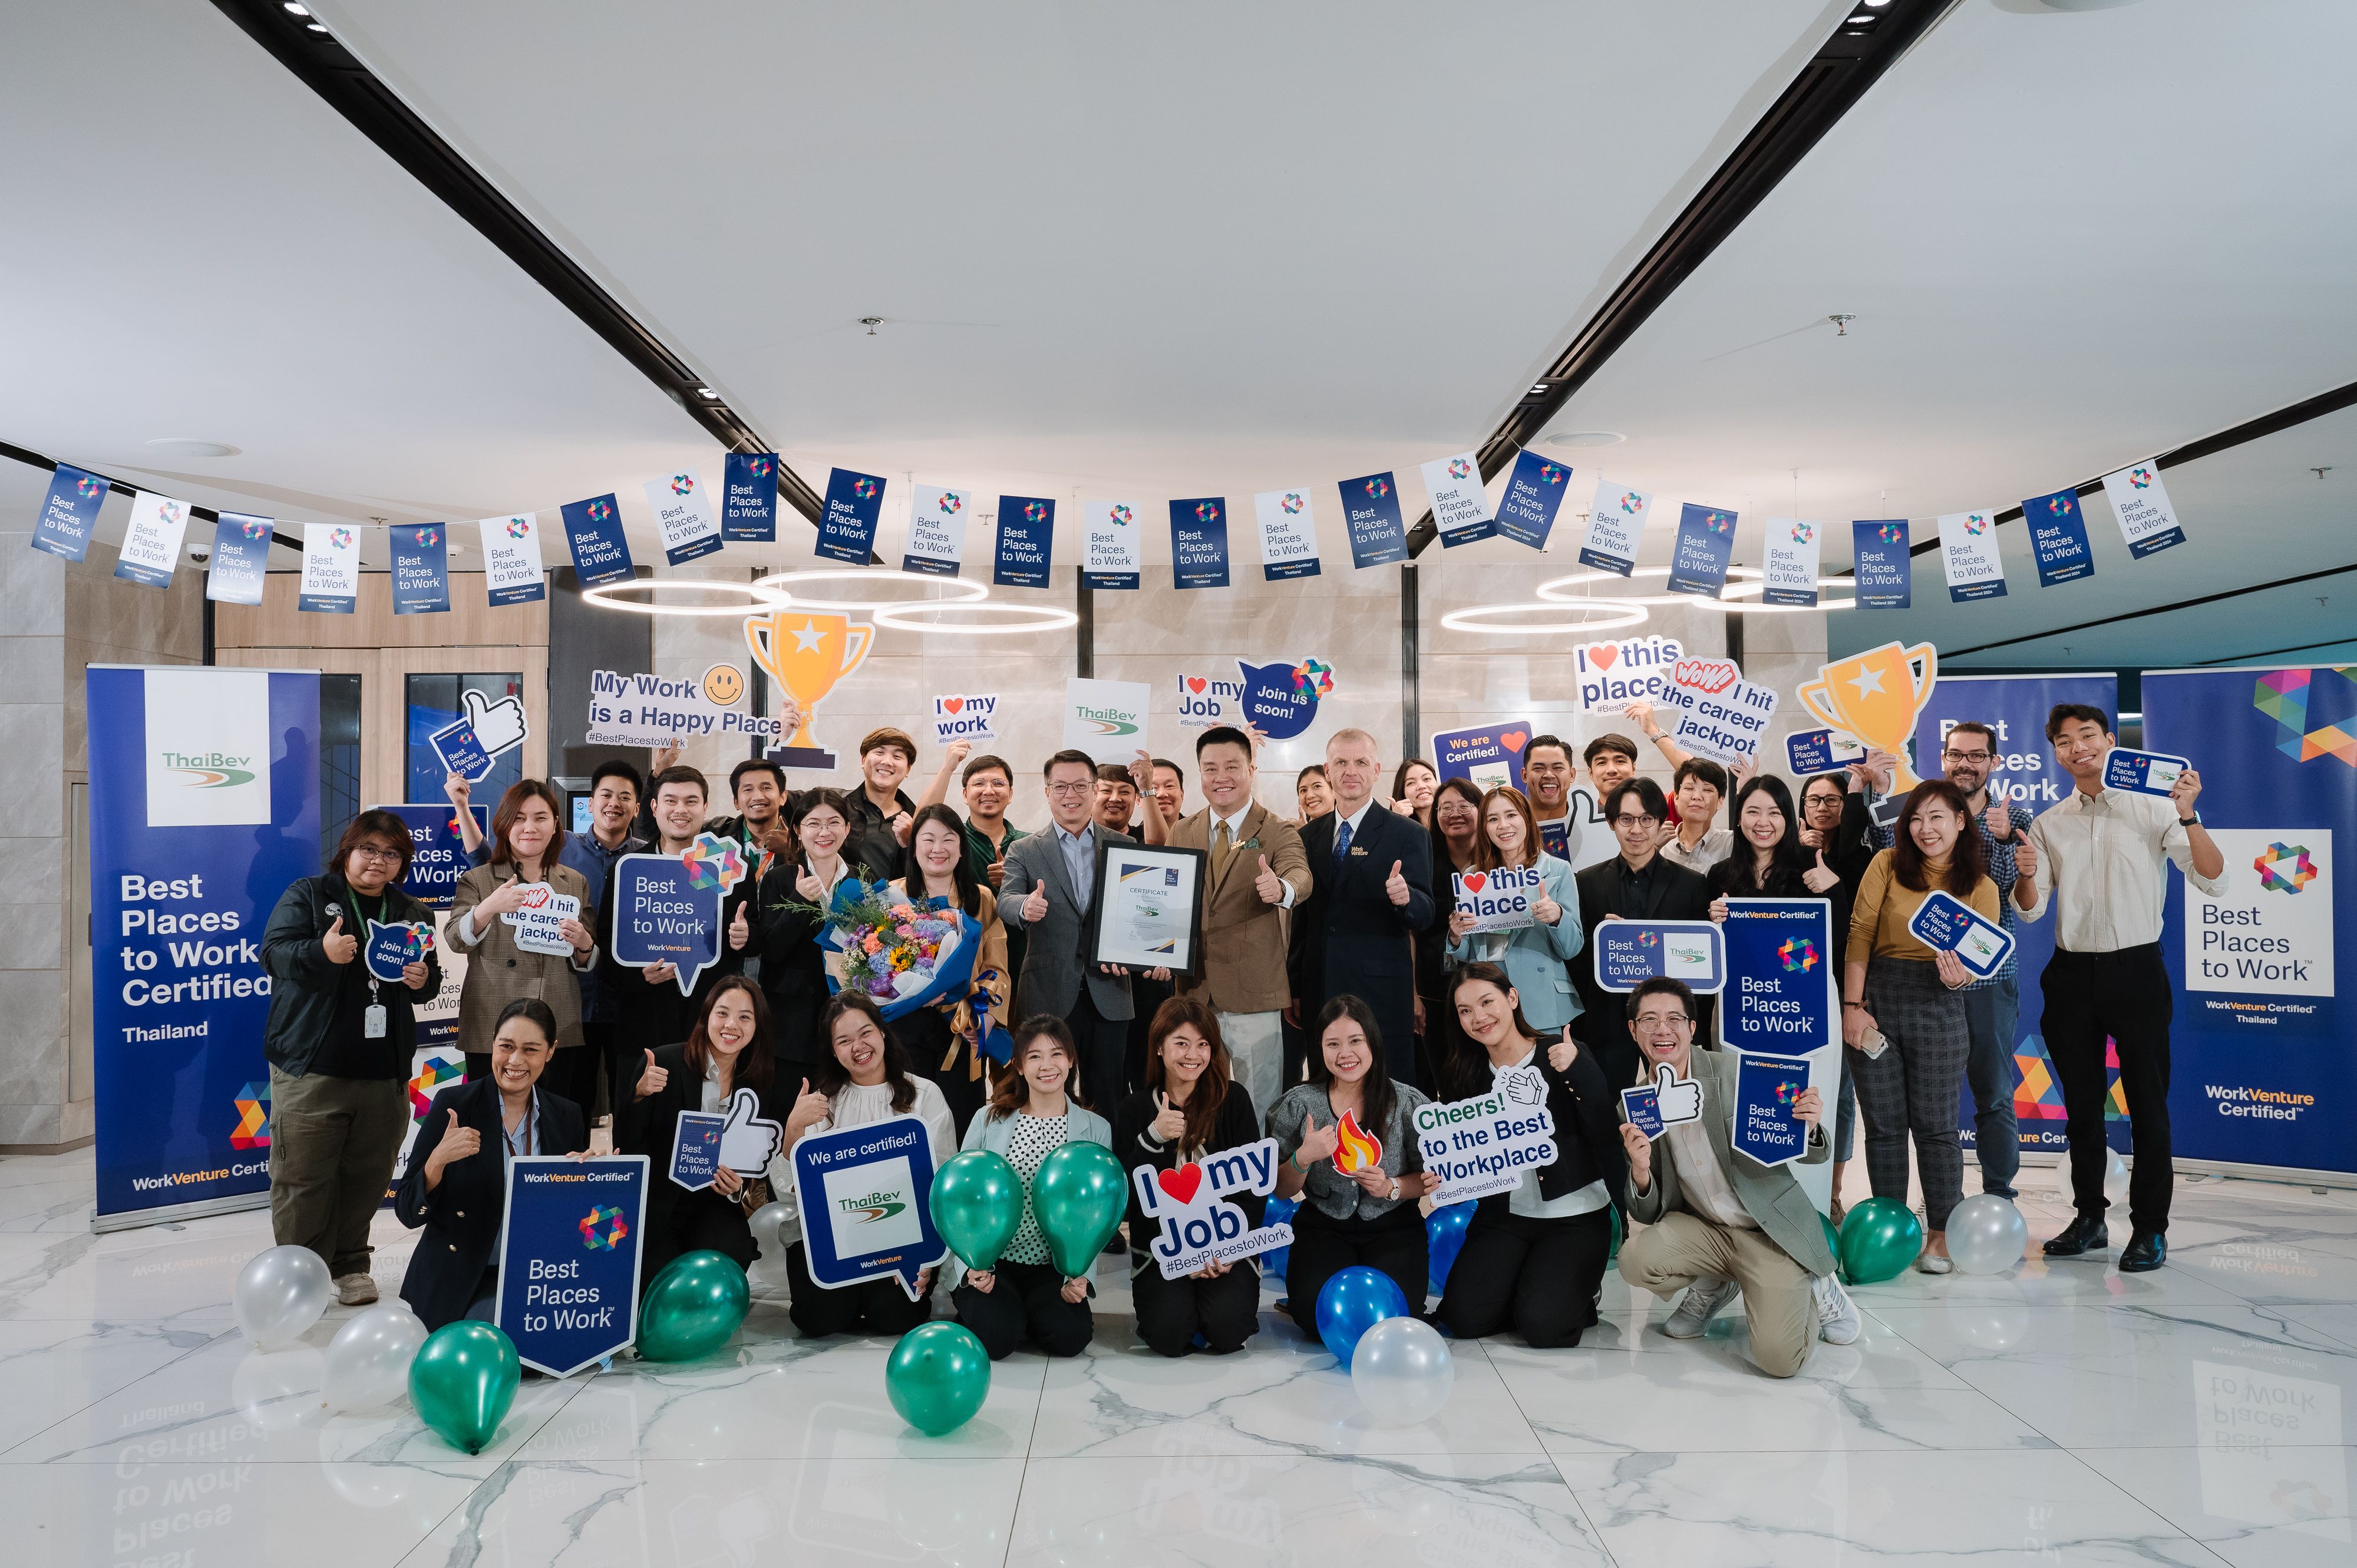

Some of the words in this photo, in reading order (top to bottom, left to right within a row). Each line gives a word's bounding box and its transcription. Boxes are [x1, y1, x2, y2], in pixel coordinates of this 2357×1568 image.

[731, 485, 752, 494] Best
[730, 496, 762, 506] Places
[2121, 499, 2144, 513] Best
[729, 509, 739, 517] to
[2125, 507, 2158, 524] Places
[1092, 533, 1114, 542] Best
[2129, 526, 2140, 535] to
[1091, 544, 1124, 554] Places
[2137, 539, 2159, 549] WorkVenture
[2146, 543, 2163, 552] Thailand
[1091, 557, 1101, 565] to
[1579, 649, 1585, 672] I
[1622, 641, 1679, 668] this
[595, 673, 628, 698] My
[637, 675, 696, 699] Work
[1179, 675, 1183, 692] I
[1212, 681, 1244, 701] my
[1582, 676, 1662, 709] place
[1257, 686, 1286, 701] Join
[1292, 694, 1308, 705] us
[1734, 684, 1741, 700] I
[1745, 688, 1772, 711] hit
[937, 699, 941, 714] I
[966, 697, 996, 713] my
[1077, 706, 1137, 721] ThaiBev
[1179, 696, 1220, 717] Job
[1255, 704, 1293, 719] soon!
[1662, 685, 1694, 708] the
[1699, 701, 1765, 732] career
[592, 703, 612, 722] is
[619, 709, 632, 724] a
[642, 707, 715, 735] Happy
[723, 713, 781, 735] Place
[937, 716, 988, 735] work
[1450, 738, 1468, 750] We
[1471, 736, 1489, 746] are
[1677, 716, 1756, 755] jackpot
[162, 752, 250, 768] ThaiBev
[1447, 746, 1499, 762] Certified!
[1795, 751, 1819, 759] Places
[2112, 767, 2136, 776] Places
[2114, 760, 2130, 768] Best
[1476, 775, 1504, 783] ThaiBev
[122, 874, 202, 902] Best
[636, 877, 676, 894] Best
[1453, 875, 1460, 894] I
[1491, 867, 1540, 890] this
[1130, 887, 1168, 896] CERTIFICATE
[550, 899, 553, 909] I
[557, 900, 574, 912] hit
[635, 897, 694, 915] Places
[123, 909, 240, 936] Places
[531, 914, 565, 925] care
[2203, 905, 2262, 925] Best
[520, 925, 563, 942] jackpo
[633, 919, 652, 933] to
[380, 940, 401, 952] Join
[403, 948, 414, 956] us
[523, 940, 567, 950] #BestPlacestoWork
[1609, 940, 1633, 950] Best
[2203, 930, 2289, 953] Places
[121, 946, 157, 972] to
[168, 938, 259, 968] Work
[376, 952, 404, 965] soon!
[1609, 952, 1645, 963] Places
[1609, 966, 1620, 975] to
[2202, 959, 2229, 978] to
[1741, 976, 1781, 992] Best
[1741, 996, 1800, 1012] Places
[2206, 1001, 2266, 1011] WorkVenture
[1741, 1018, 1760, 1031] to
[2236, 1015, 2277, 1024] Thailand
[123, 1022, 208, 1043] Thailand
[2206, 1085, 2315, 1105] WorkVenture
[1418, 1093, 1504, 1131] Cheers!
[1749, 1104, 1776, 1117] Best
[1748, 1118, 1787, 1131] Places
[1424, 1138, 1444, 1157] to
[1452, 1130, 1488, 1151] the
[1494, 1111, 1548, 1141] Best
[1748, 1130, 1760, 1141] to
[682, 1144, 702, 1153] Best
[808, 1152, 829, 1166] We
[832, 1148, 857, 1162] are
[861, 1132, 917, 1156] certified!
[681, 1154, 709, 1164] Places
[1431, 1141, 1552, 1183] Workplace
[133, 1168, 229, 1191] WorkVenture
[232, 1160, 269, 1176] Certi
[679, 1165, 688, 1173] to
[524, 1173, 586, 1183] WorkVenture
[1141, 1172, 1157, 1209] I
[1207, 1147, 1273, 1189] my
[1435, 1176, 1516, 1201] #BestPlacestoWork
[839, 1191, 901, 1212] ThaiBev
[1160, 1201, 1240, 1257] Job
[1166, 1229, 1288, 1274] #BestPlacestoWork
[529, 1259, 579, 1279] Best
[860, 1255, 902, 1268] WorkVenture
[527, 1285, 599, 1305] Places
[524, 1313, 547, 1332] to
